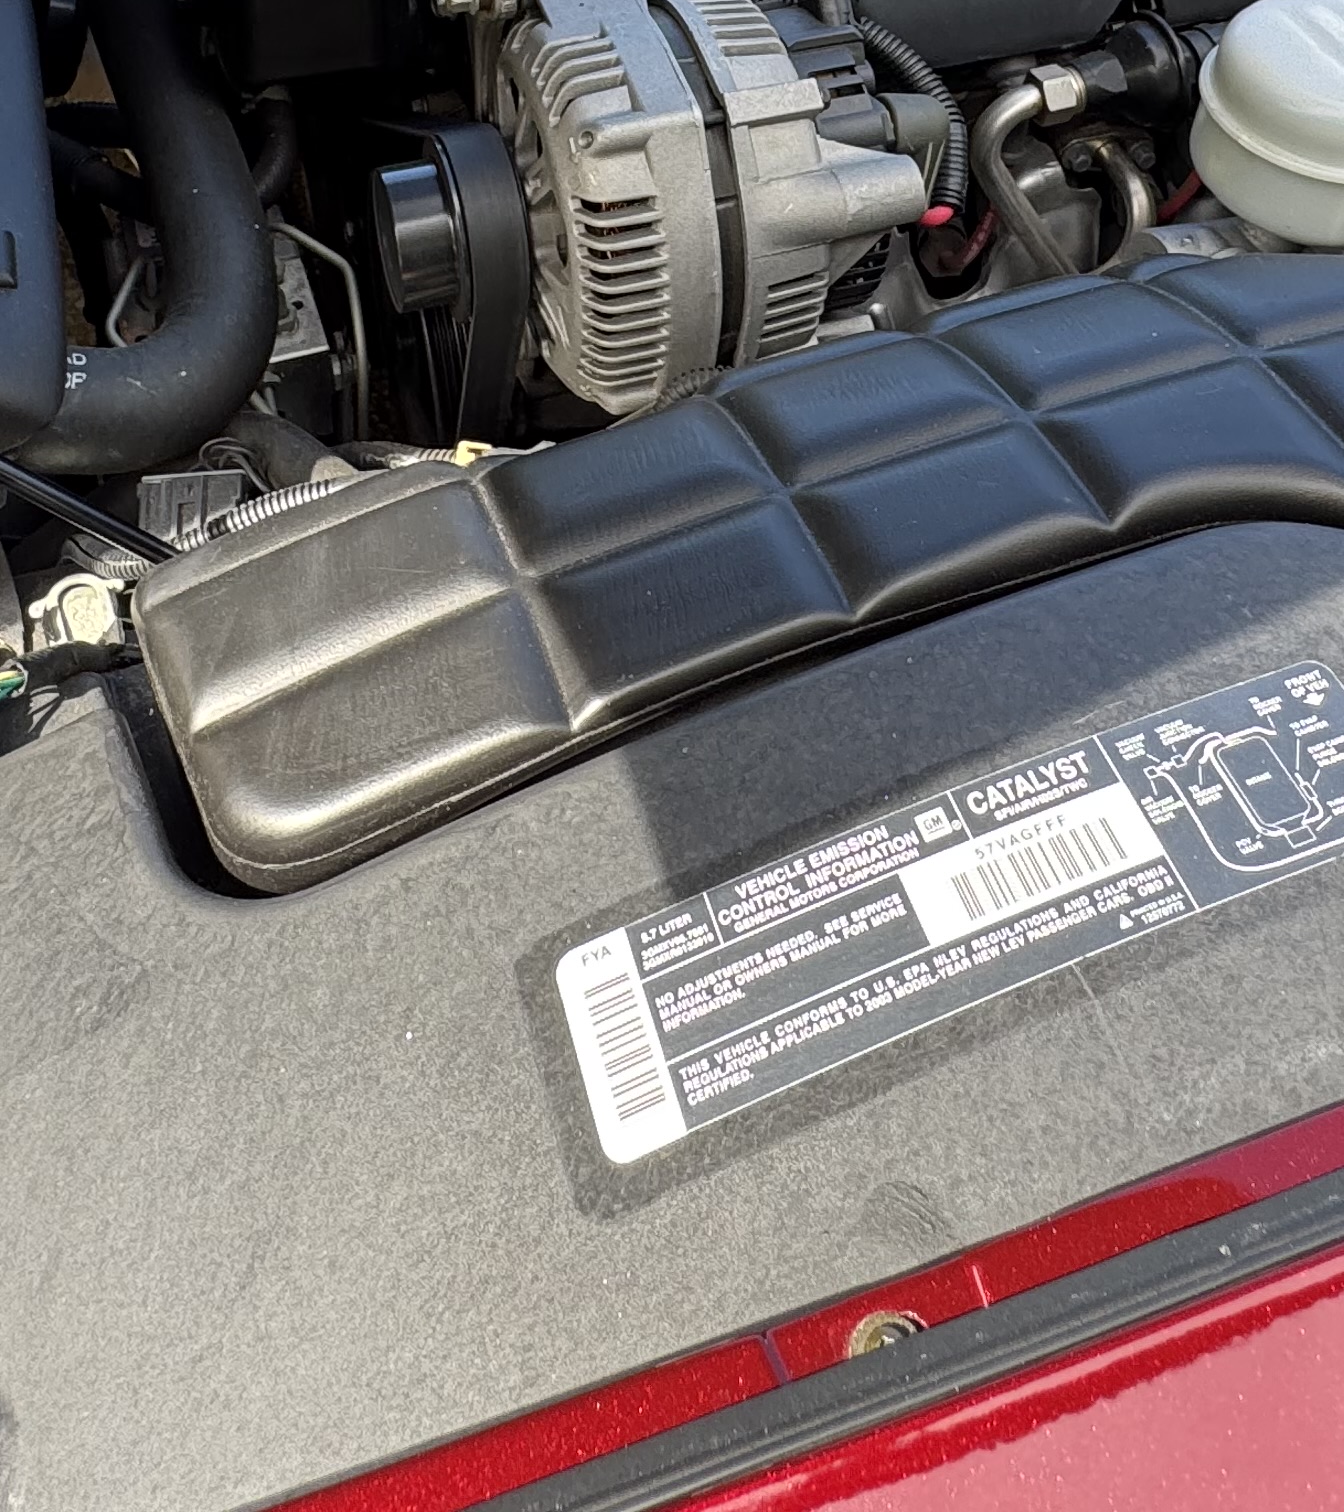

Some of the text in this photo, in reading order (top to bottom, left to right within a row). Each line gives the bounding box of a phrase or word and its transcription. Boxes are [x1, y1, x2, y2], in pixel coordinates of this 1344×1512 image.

[1284, 669, 1321, 691] FRONT
[1291, 679, 1329, 698] OF VEH
[966, 750, 1089, 815] CATALYST
[923, 815, 943, 830] GM
[975, 815, 1064, 859] 57VAGFFF
[718, 830, 919, 926] CONTROL INFORMATION
[734, 825, 889, 899] VEHICLE EMISSION
[734, 847, 919, 933] GENERAL MOTORS CORPORATION
[655, 893, 902, 1008] NO ADJUSTMENTS NEEDED. SEE SERVICE
[658, 913, 692, 936] LITER
[581, 944, 612, 967] FYA
[659, 904, 907, 1020] MANUAL OR OWNERS MANUAL FOR MORE
[678, 865, 1168, 1080] THIS VEHICLE CONFORMS TO U.S. EPA NLEV REGULATIONS AND CALIFORNIA
[662, 988, 746, 1032] INFORMATION.
[683, 1046, 769, 1093] REGULATIONS
[771, 1012, 845, 1055] APPLICABLE
[845, 1004, 864, 1019] TO
[864, 991, 893, 1012] 2003
[893, 957, 972, 999] MODEL-YEAR
[972, 945, 1000, 965] NEW
[1001, 934, 1024, 953] LEV
[1026, 906, 1097, 943] PASSENGER
[1097, 892, 1134, 913] CARS.
[1137, 879, 1164, 897] OBD
[687, 1069, 754, 1106] CERTIFIED.
